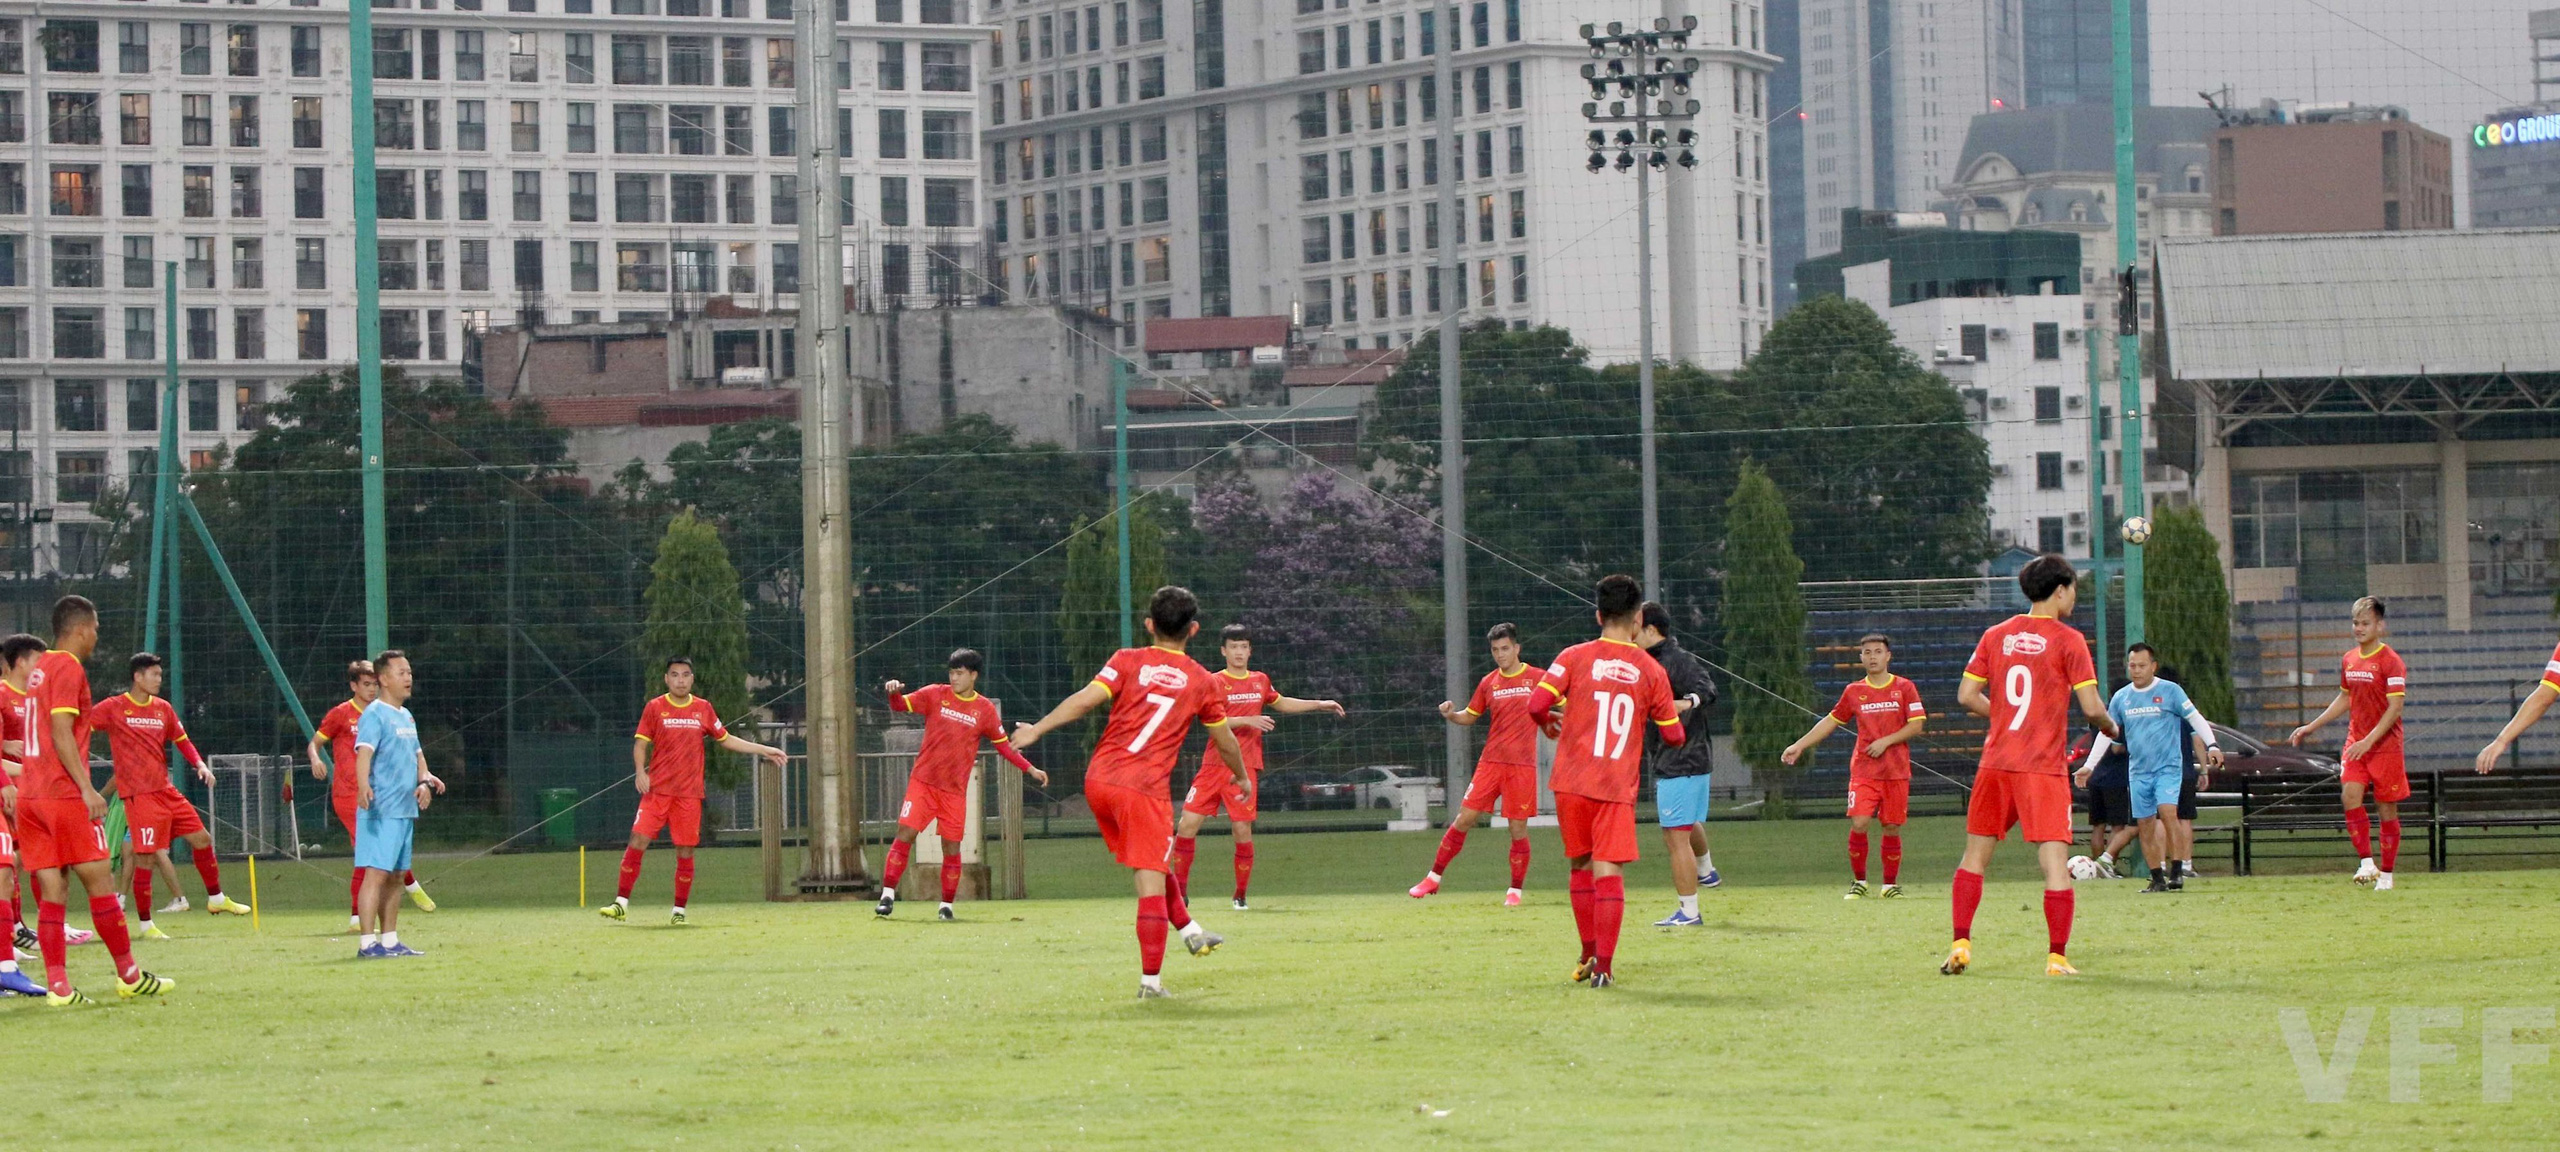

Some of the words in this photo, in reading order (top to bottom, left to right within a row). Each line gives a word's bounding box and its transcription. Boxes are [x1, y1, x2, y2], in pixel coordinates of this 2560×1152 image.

[1227, 692, 1262, 701] HONDA
[1493, 686, 1532, 697] HONDA
[2005, 664, 2032, 731] 9
[1860, 701, 1900, 711] HONDA
[2125, 706, 2161, 716] HONDA
[126, 717, 165, 726] HONDA
[663, 718, 701, 726] HONDA
[940, 706, 977, 725] HONDA
[1127, 693, 1176, 753] 7
[25, 697, 40, 756] 11
[1593, 691, 1635, 760] 19
[141, 827, 154, 846] 12
